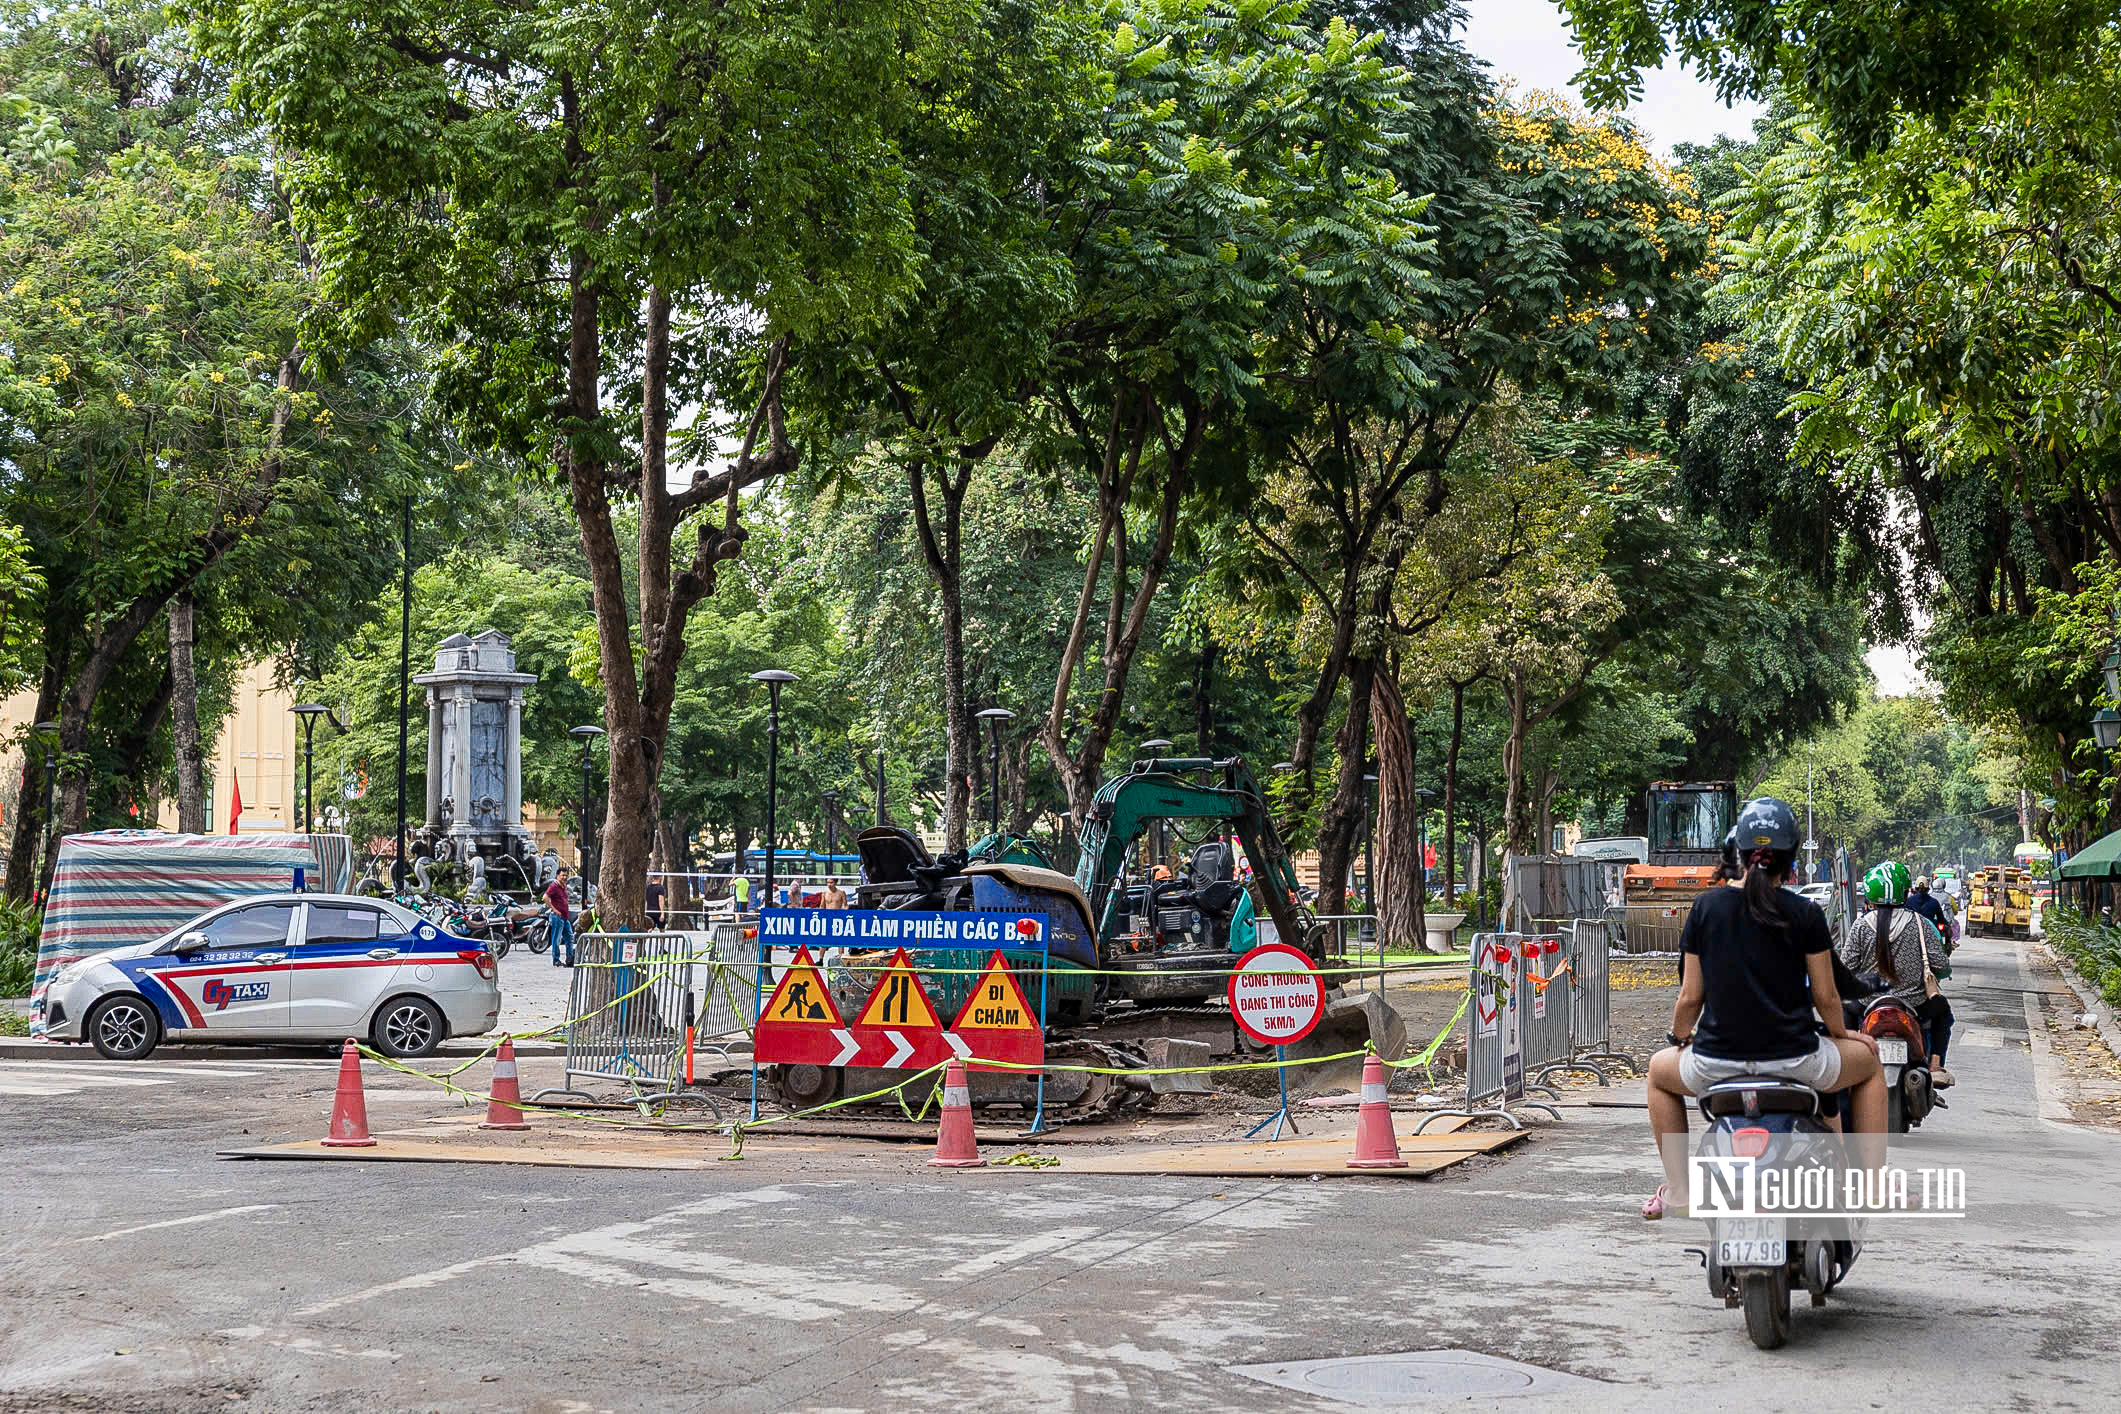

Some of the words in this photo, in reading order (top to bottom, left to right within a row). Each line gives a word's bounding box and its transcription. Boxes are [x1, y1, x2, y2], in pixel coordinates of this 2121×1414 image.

[764, 917, 795, 935] XIN
[800, 911, 827, 937] LỖI
[831, 915, 856, 937] ĐÃ
[860, 915, 899, 938] LÀM
[903, 914, 957, 939] PHIỀN
[962, 918, 999, 940] CÁC
[242, 951, 254, 959] 32
[203, 978, 234, 1011] G7
[234, 983, 269, 998] TAXI
[989, 984, 1004, 1001] ĐI
[1240, 997, 1268, 1011] ĐANG
[1270, 995, 1286, 1009] THI
[1288, 992, 1315, 1008] CÔNG
[974, 1006, 1019, 1027] CHẬM
[1263, 1015, 1296, 1030] 5KM/h
[1721, 1241, 1781, 1262] 617.96
